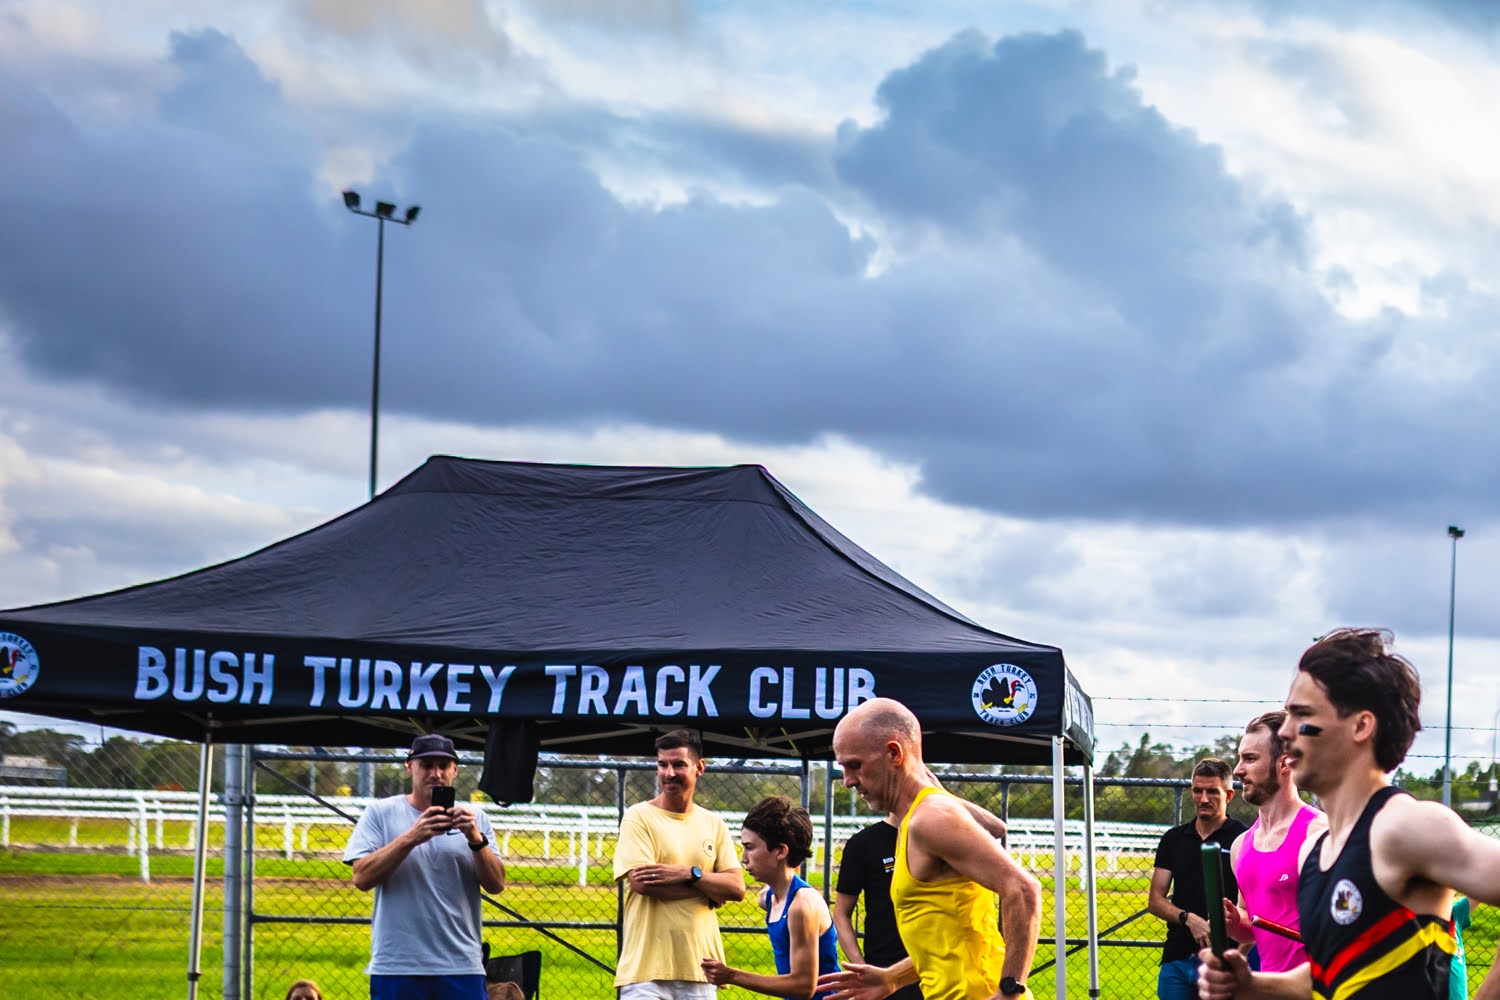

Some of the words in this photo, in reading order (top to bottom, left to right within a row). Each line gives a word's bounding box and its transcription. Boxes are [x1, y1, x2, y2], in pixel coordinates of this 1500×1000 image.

[134, 645, 275, 705] BUSH
[303, 655, 518, 714] TURKEY
[545, 664, 722, 718] TRACK
[748, 666, 877, 720] CLUB
[976, 666, 997, 685] BUSH
[1001, 664, 1032, 684] TURKEY
[980, 709, 1005, 726] TRACK
[1010, 710, 1030, 725] CLUB
